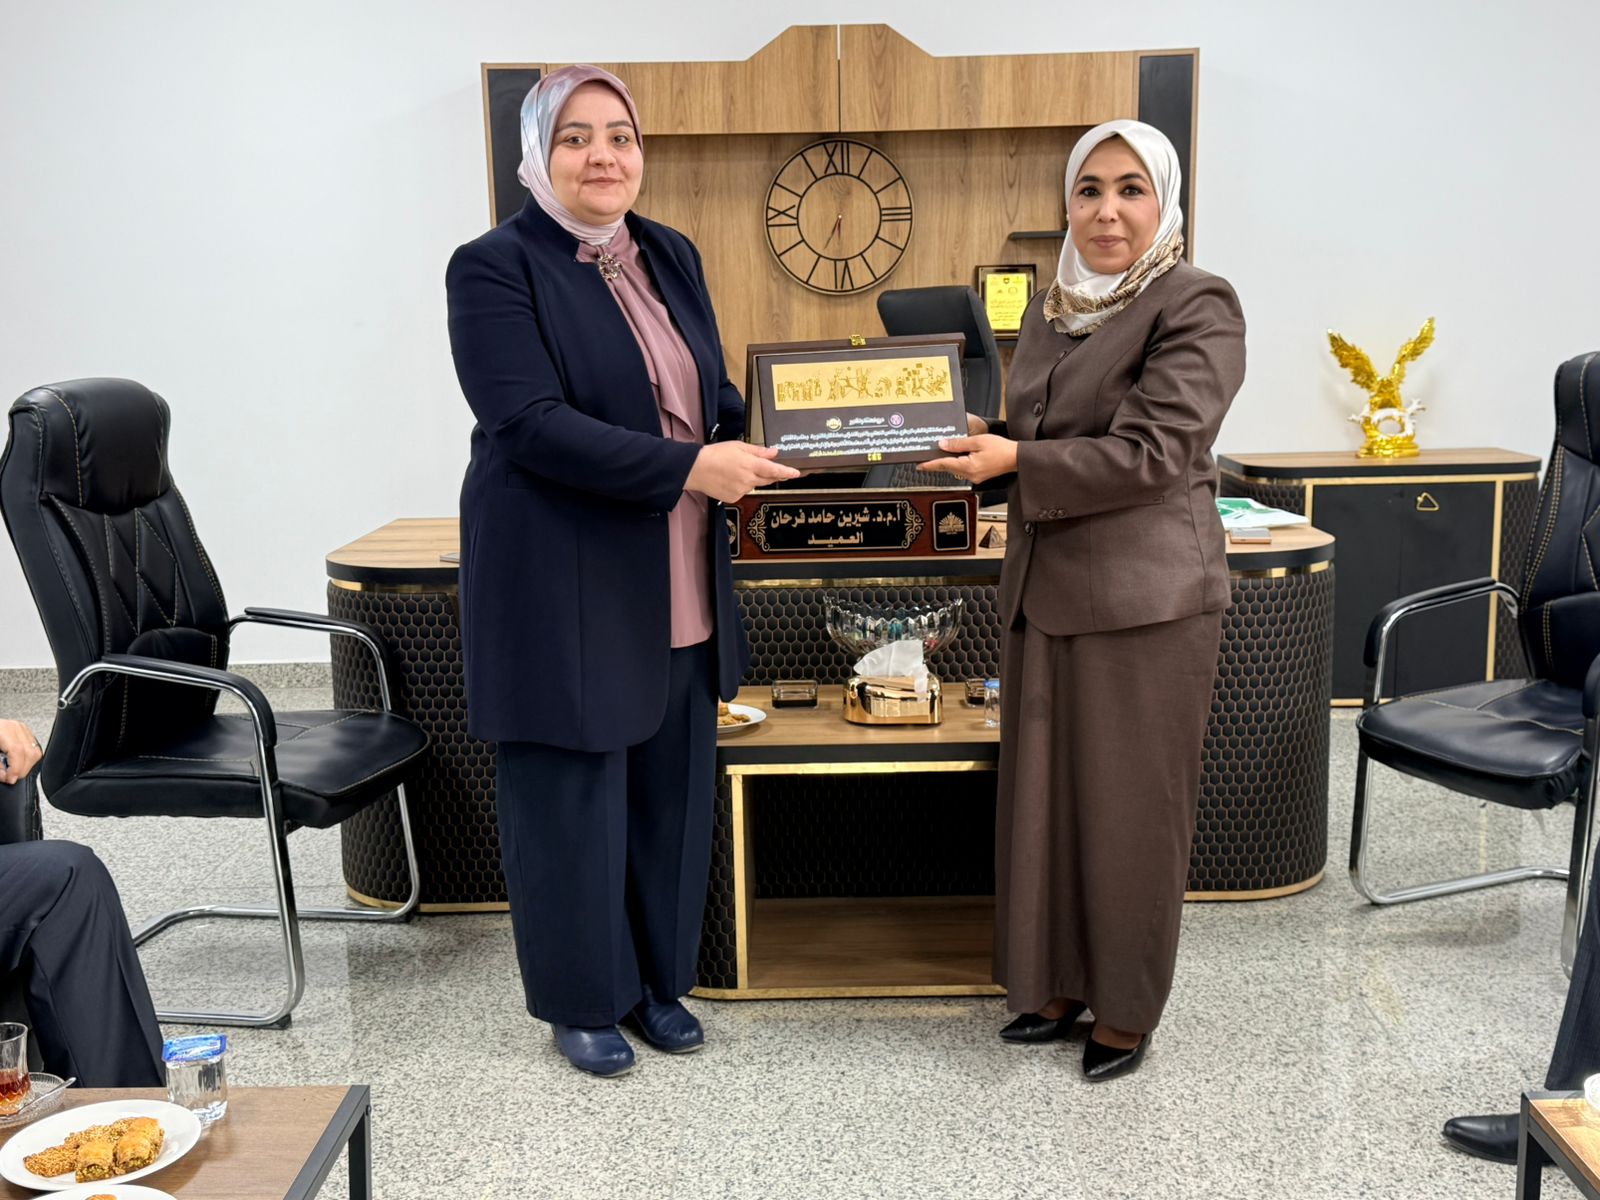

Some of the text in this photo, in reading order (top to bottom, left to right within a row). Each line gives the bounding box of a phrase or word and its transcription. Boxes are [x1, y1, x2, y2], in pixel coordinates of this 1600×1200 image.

[771, 508, 805, 528] فرحان
[808, 508, 835, 524] حامد
[837, 506, 870, 528] شيرين
[808, 531, 864, 548] العميد
